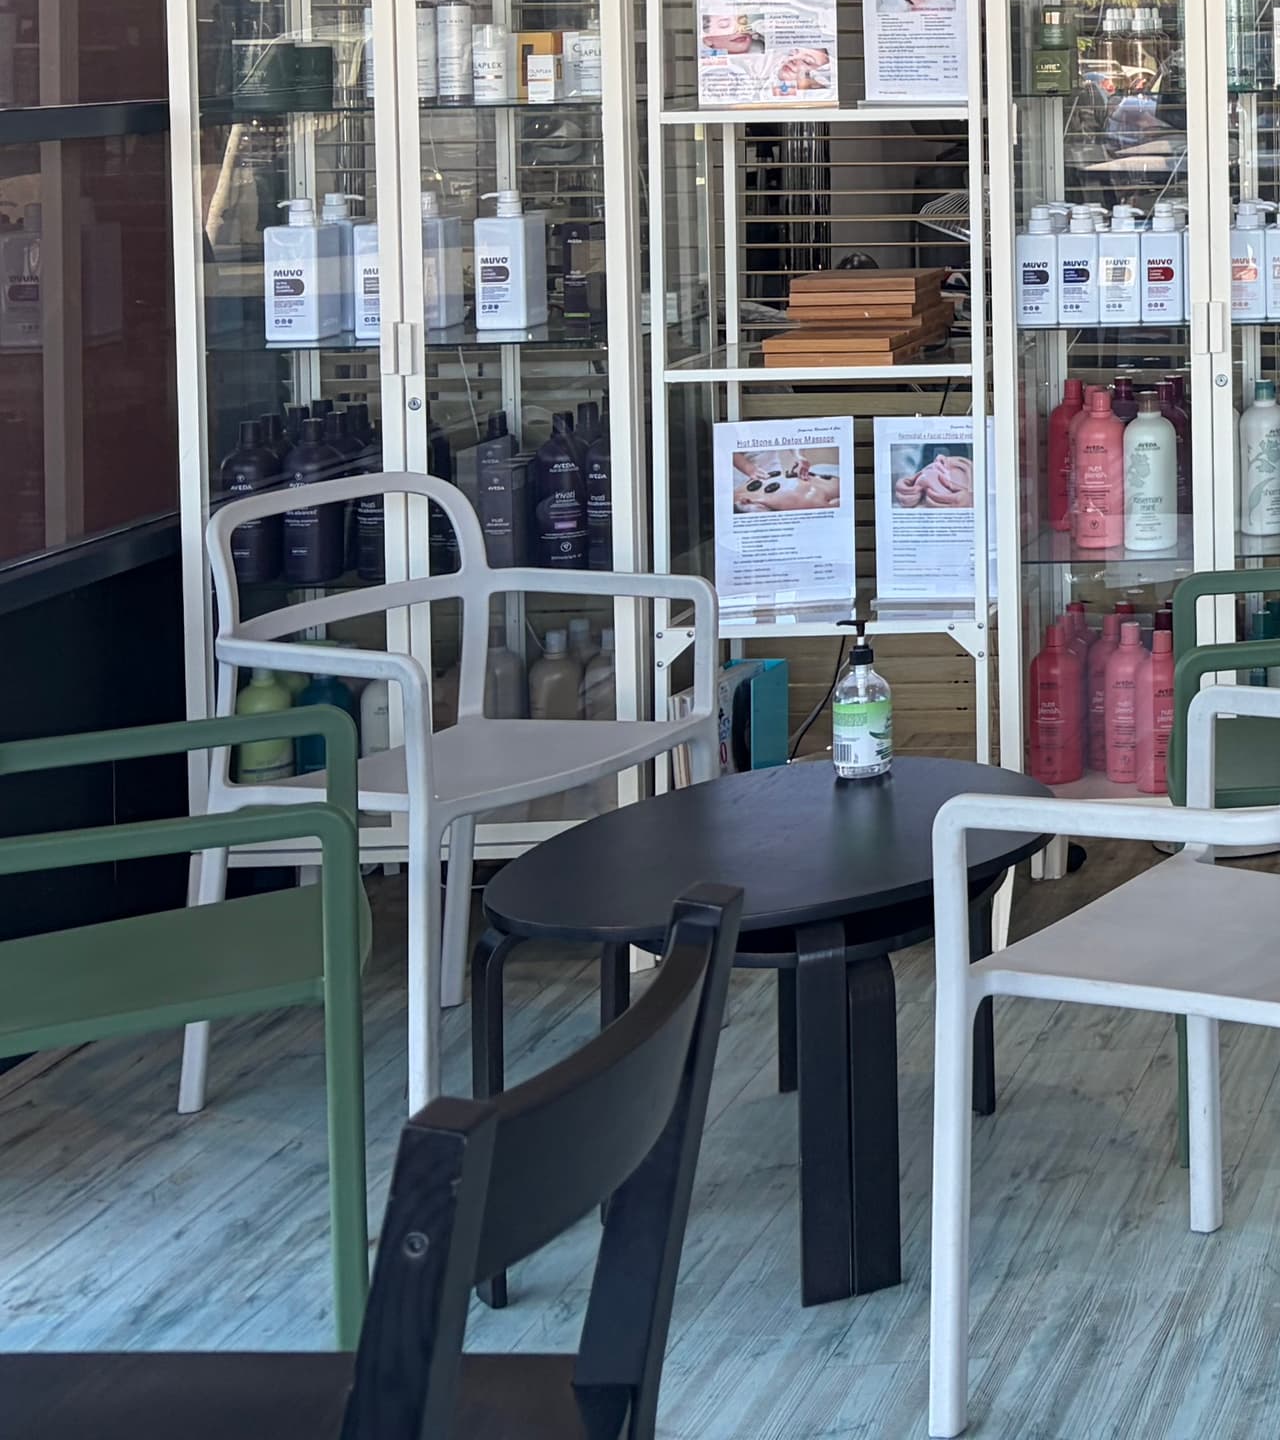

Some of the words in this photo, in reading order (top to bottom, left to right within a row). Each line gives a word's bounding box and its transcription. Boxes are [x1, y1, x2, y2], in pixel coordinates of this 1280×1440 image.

[480, 257, 508, 265] MUVO
[273, 269, 303, 278] MUVO
[363, 268, 379, 276] MU
